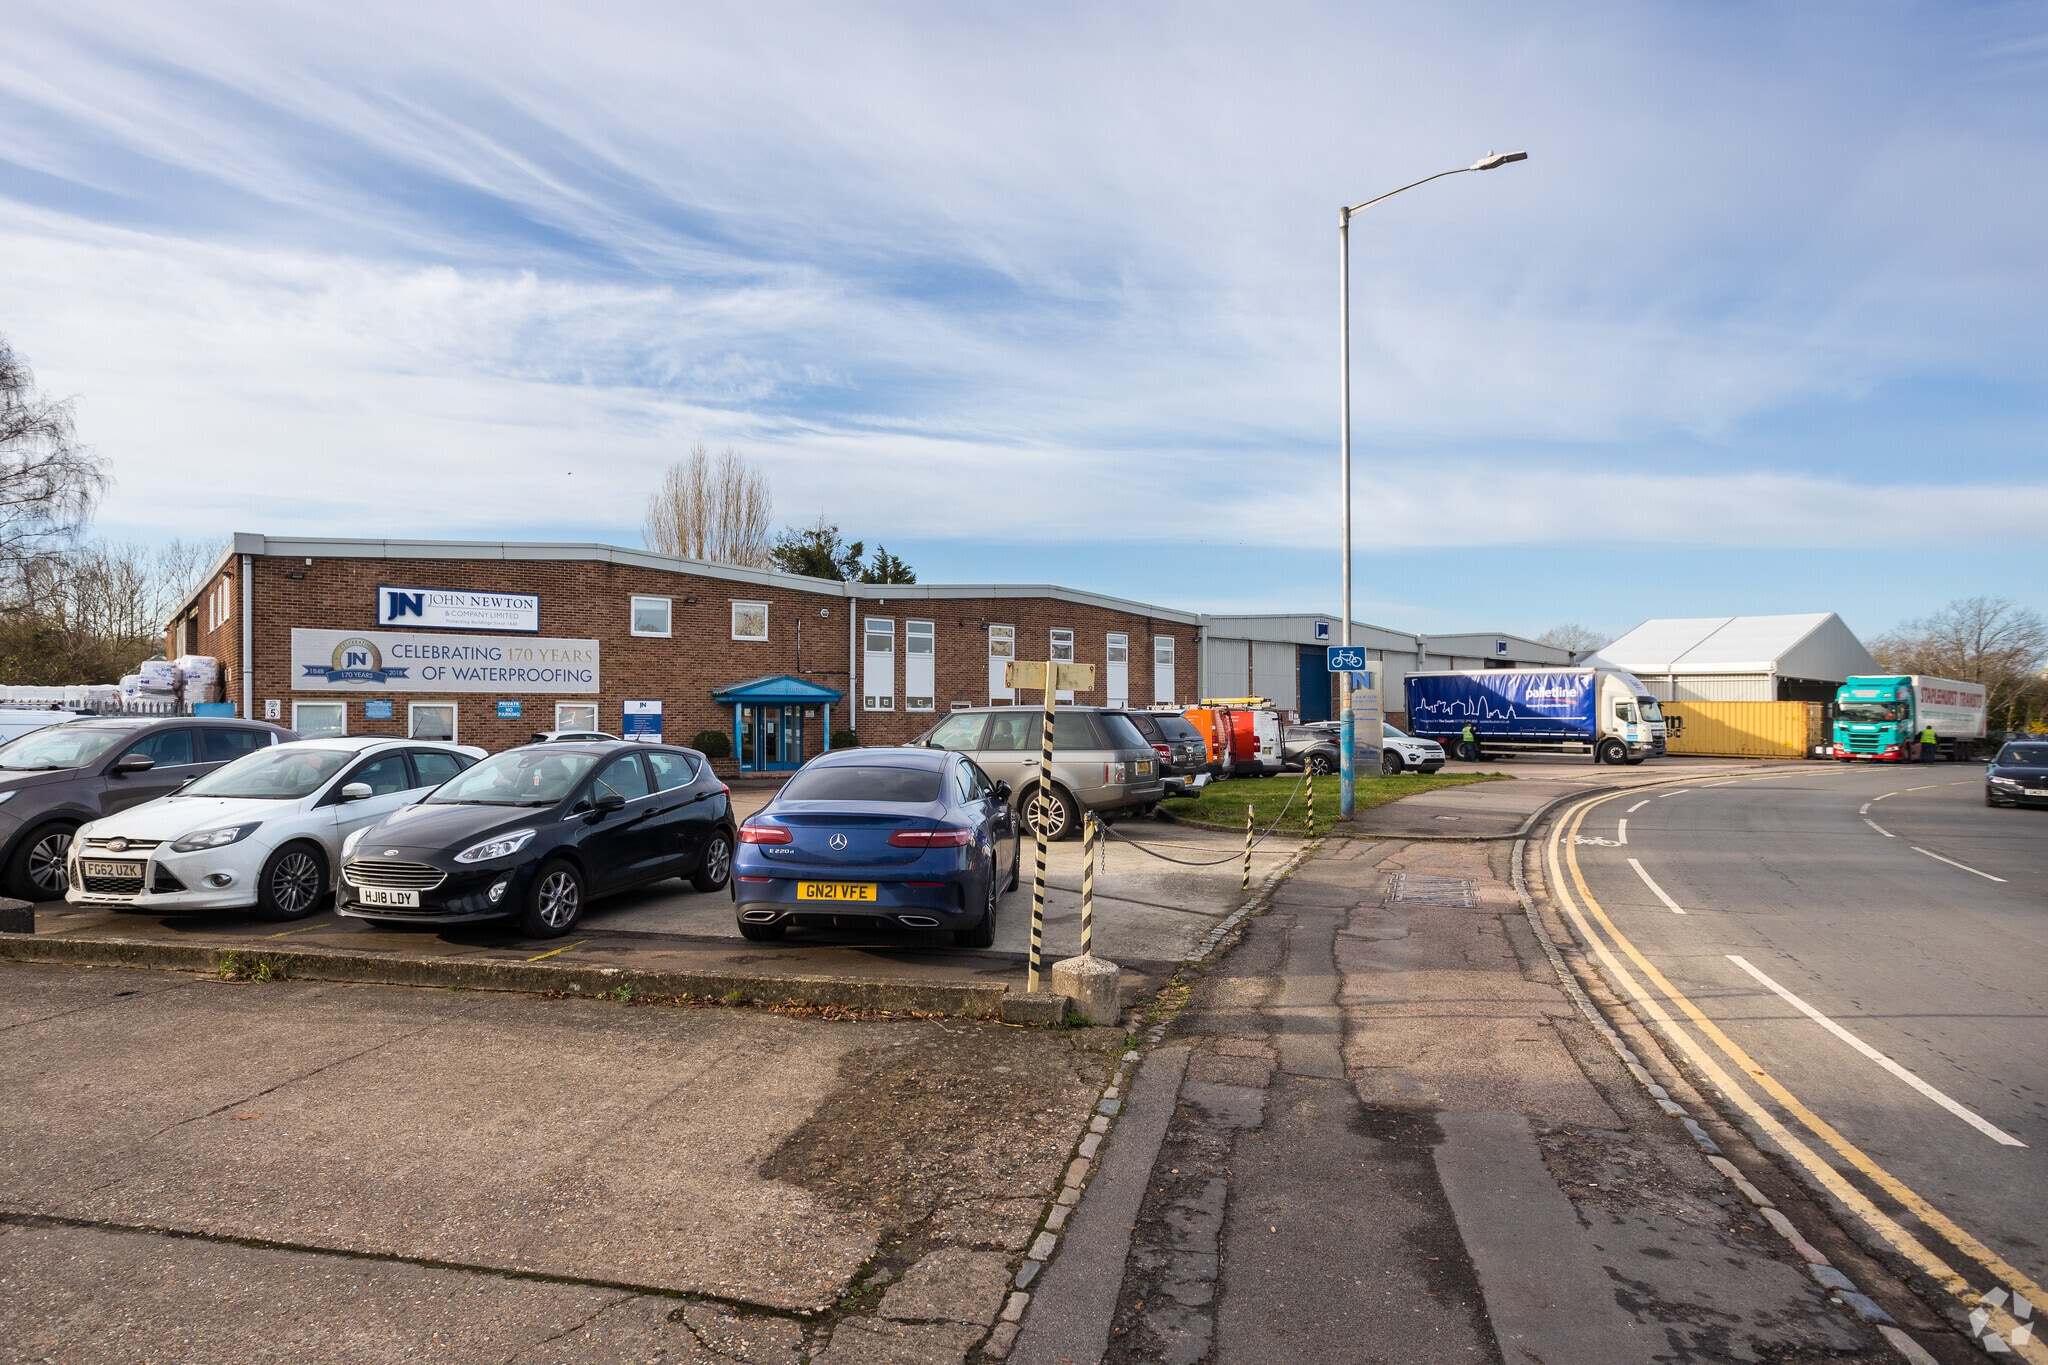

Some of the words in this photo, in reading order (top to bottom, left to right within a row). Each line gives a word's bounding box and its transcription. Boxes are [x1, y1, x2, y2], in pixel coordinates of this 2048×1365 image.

[387, 591, 425, 621] JN
[428, 594, 465, 607] JOHN
[470, 596, 533, 609] NEWTON
[451, 610, 489, 618] COMPANY
[490, 612, 519, 620] LIMITED
[346, 651, 368, 668] JN
[391, 644, 502, 661] CELEBRATING
[508, 648, 533, 661] 170
[539, 649, 593, 663] YEARS
[422, 666, 446, 681] OF
[452, 667, 593, 683] WATERPROOFING
[1526, 686, 1577, 701] palletline
[270, 708, 276, 718] 5
[88, 863, 113, 876] FG62
[115, 864, 137, 876] UZK
[365, 890, 387, 903] HJ18
[389, 891, 411, 905] LDY
[806, 884, 837, 898] GN21
[841, 885, 868, 899] VFE
